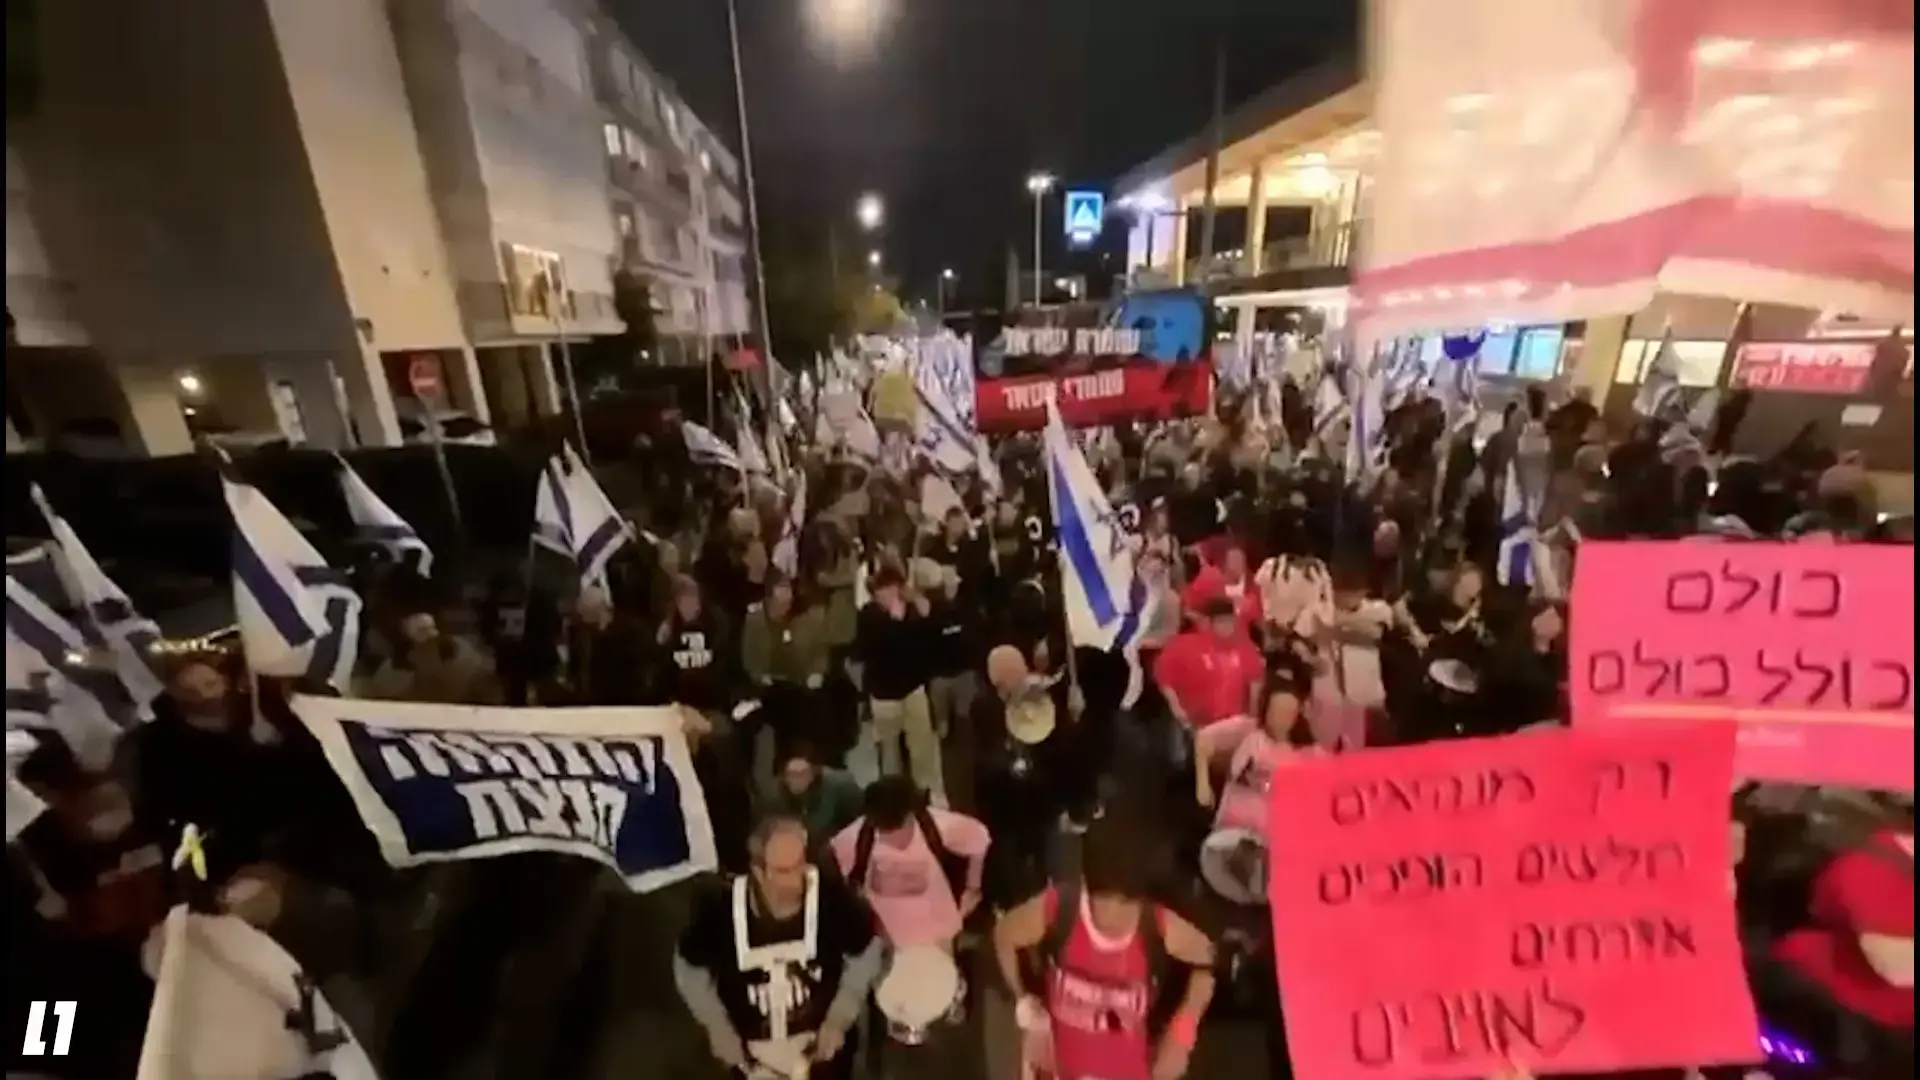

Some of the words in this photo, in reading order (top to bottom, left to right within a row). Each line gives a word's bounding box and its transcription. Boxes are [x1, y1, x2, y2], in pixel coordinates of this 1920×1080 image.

[1666, 558, 1841, 618] כולם
[1588, 639, 1730, 697] כולם
[1757, 647, 1911, 710] כולל
[1330, 769, 1536, 826] מנהיגים
[1591, 760, 1671, 814] רק
[1318, 852, 1484, 906] הופכים
[1514, 835, 1687, 885] חלשים
[1510, 916, 1697, 968] אזרחים
[1351, 975, 1586, 1067] לאויבים
